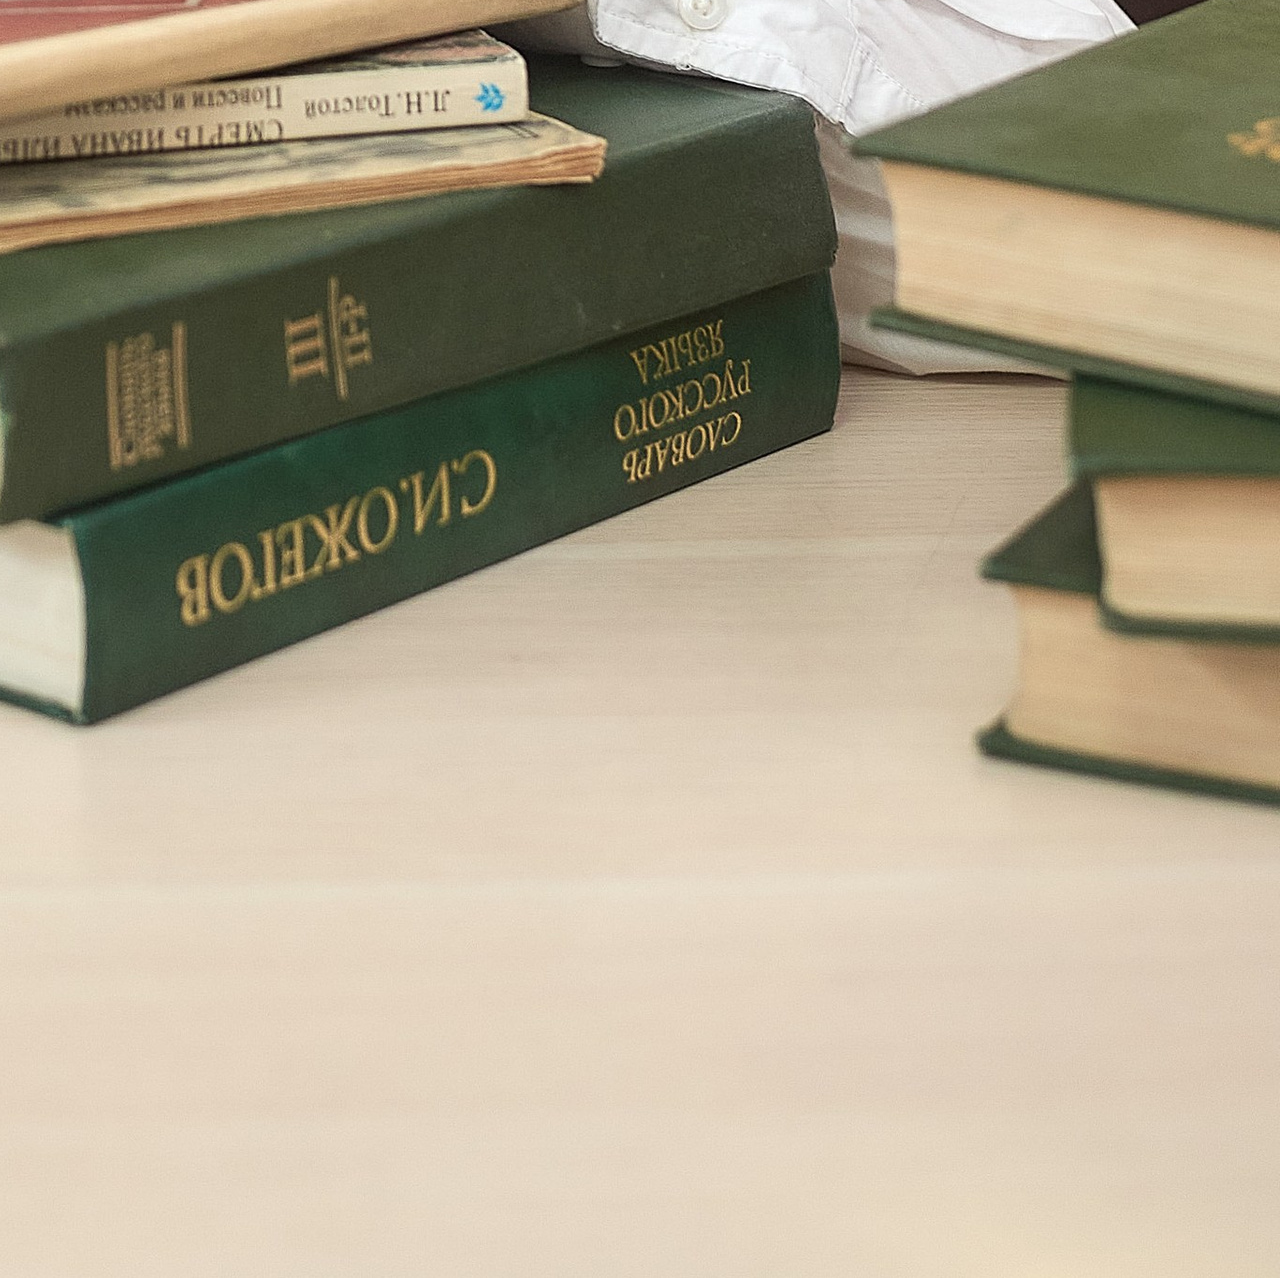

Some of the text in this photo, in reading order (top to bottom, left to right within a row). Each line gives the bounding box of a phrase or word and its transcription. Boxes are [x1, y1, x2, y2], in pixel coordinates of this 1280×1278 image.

[173, 92, 185, 110] и
[192, 85, 283, 110] Повести
[304, 88, 450, 118] Л.Н.Толстой
[71, 126, 165, 160] ИВАНА
[175, 119, 284, 152] СМЕРТЬ
[629, 318, 725, 386] ЯЗЫКА
[613, 358, 752, 441] РУССКОГО
[622, 411, 742, 483] СЛОВАРЬ
